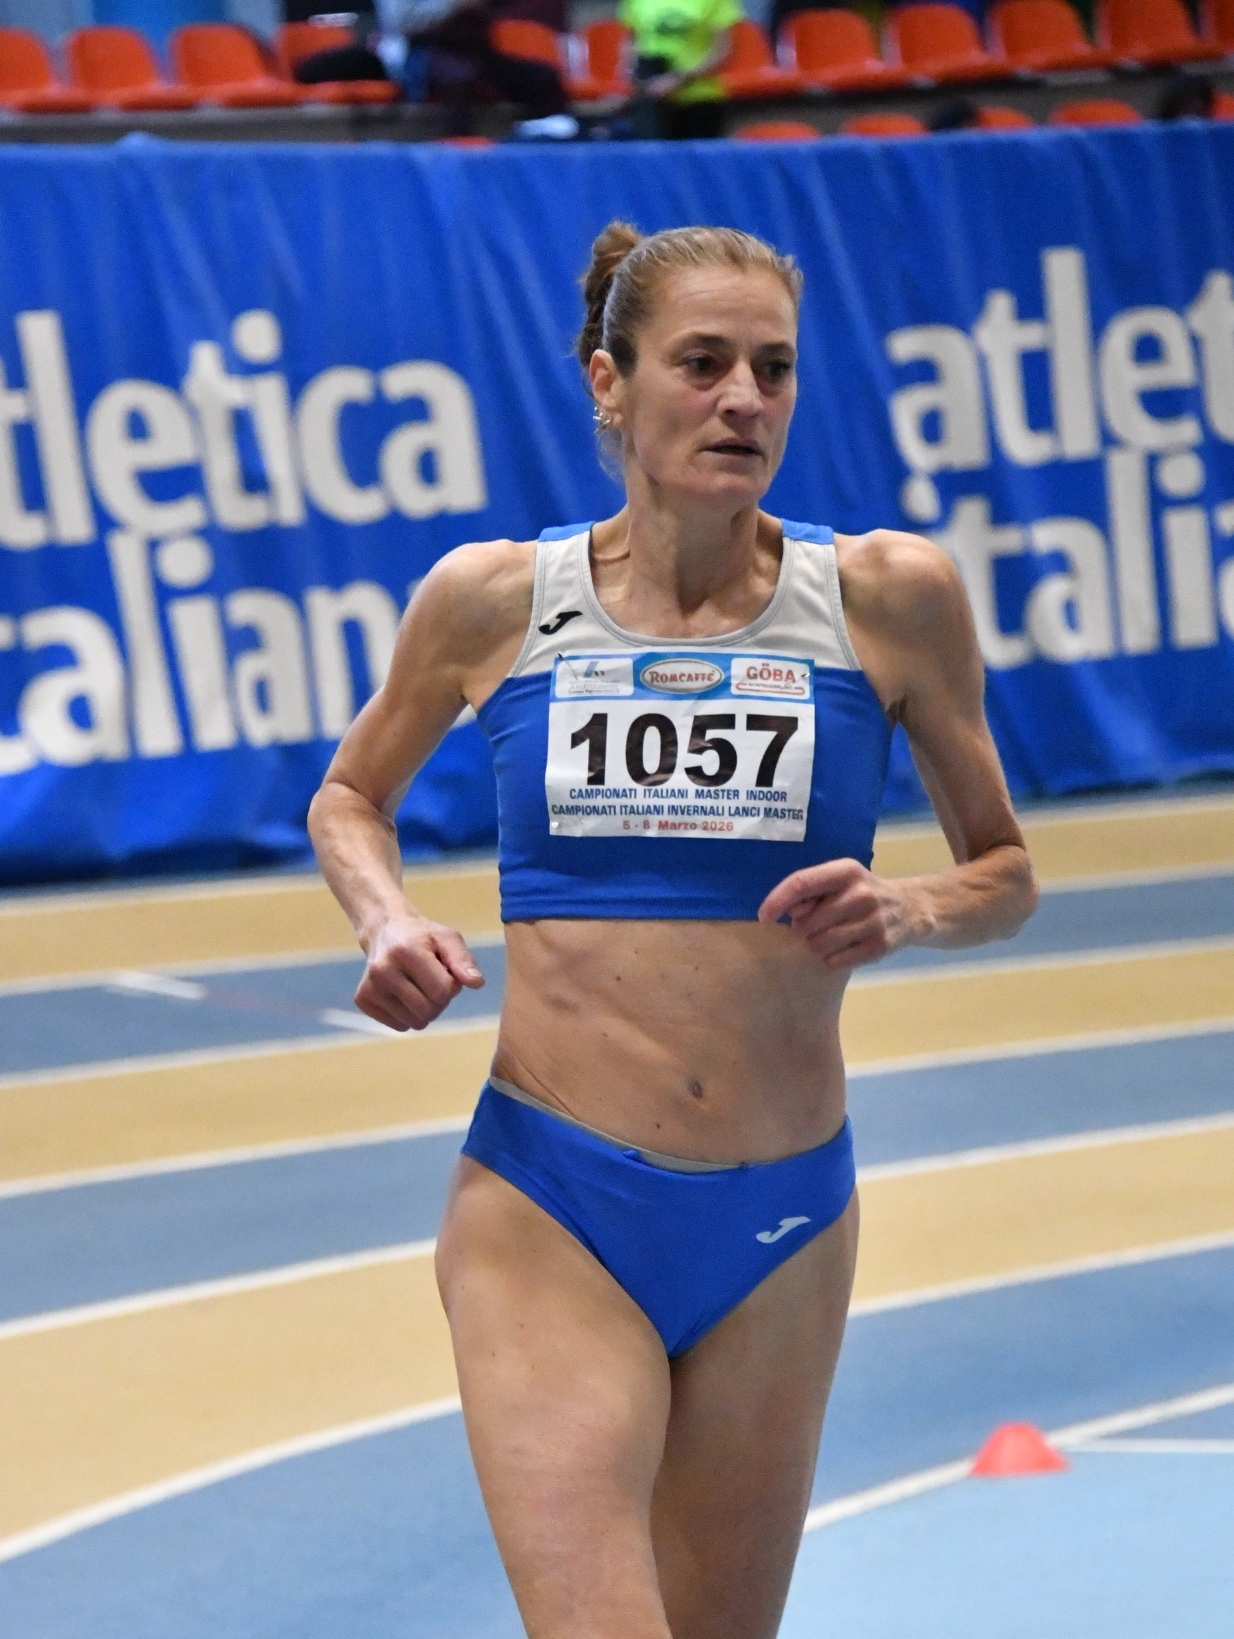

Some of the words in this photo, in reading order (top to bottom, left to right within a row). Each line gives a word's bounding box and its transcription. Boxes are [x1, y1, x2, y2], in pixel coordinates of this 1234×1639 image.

[900, 473, 1234, 670] tali
[0, 527, 478, 776] alian
[746, 662, 797, 683] GÖBA
[570, 712, 799, 788] 1057
[569, 788, 637, 800] CAMPIONATI
[643, 788, 689, 800] ITALIANI
[694, 788, 740, 801] MASTER
[746, 789, 788, 802] INDOOR
[551, 804, 617, 817] CAMPIONATI
[619, 804, 665, 817] ITALIANI
[667, 804, 725, 817] INVERNALI
[728, 805, 760, 818] LANCI
[622, 820, 631, 830] 5
[642, 820, 651, 830] 8
[657, 820, 698, 831] Marzo
[701, 821, 735, 832] 2026
